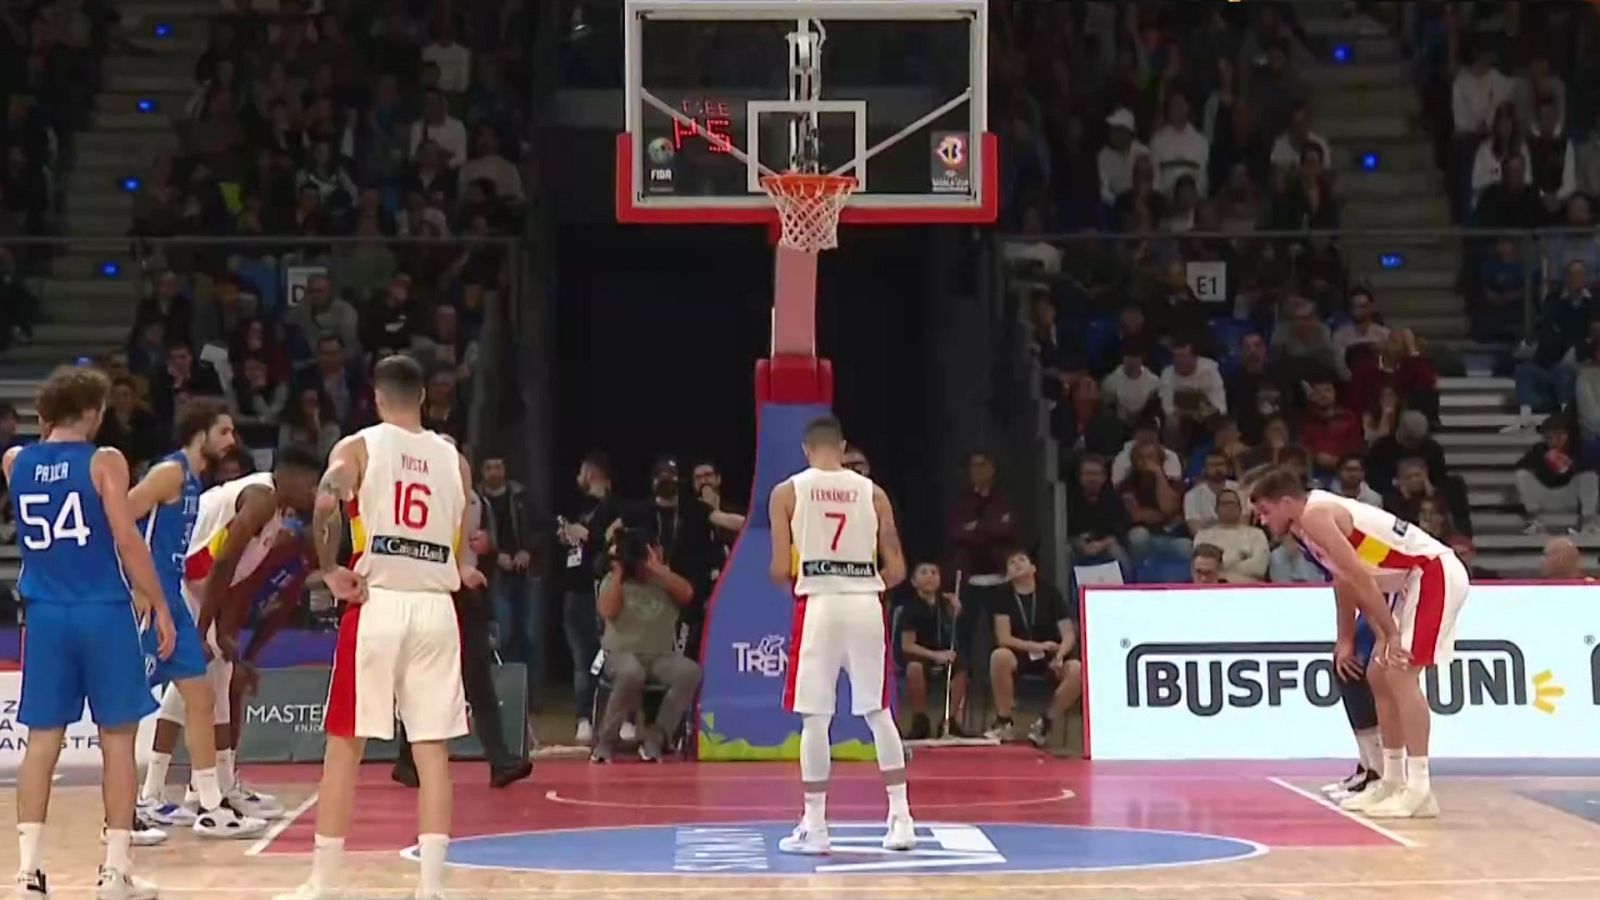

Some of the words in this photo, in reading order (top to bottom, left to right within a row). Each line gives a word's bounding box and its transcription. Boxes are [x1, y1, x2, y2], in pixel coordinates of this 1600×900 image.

[650, 168, 672, 180] FIBA
[1197, 276, 1216, 295] E1
[401, 454, 429, 474] YUSTA
[394, 481, 431, 529] 16
[19, 491, 91, 550] 54
[825, 512, 847, 551] 7
[246, 703, 331, 723] MASTE
